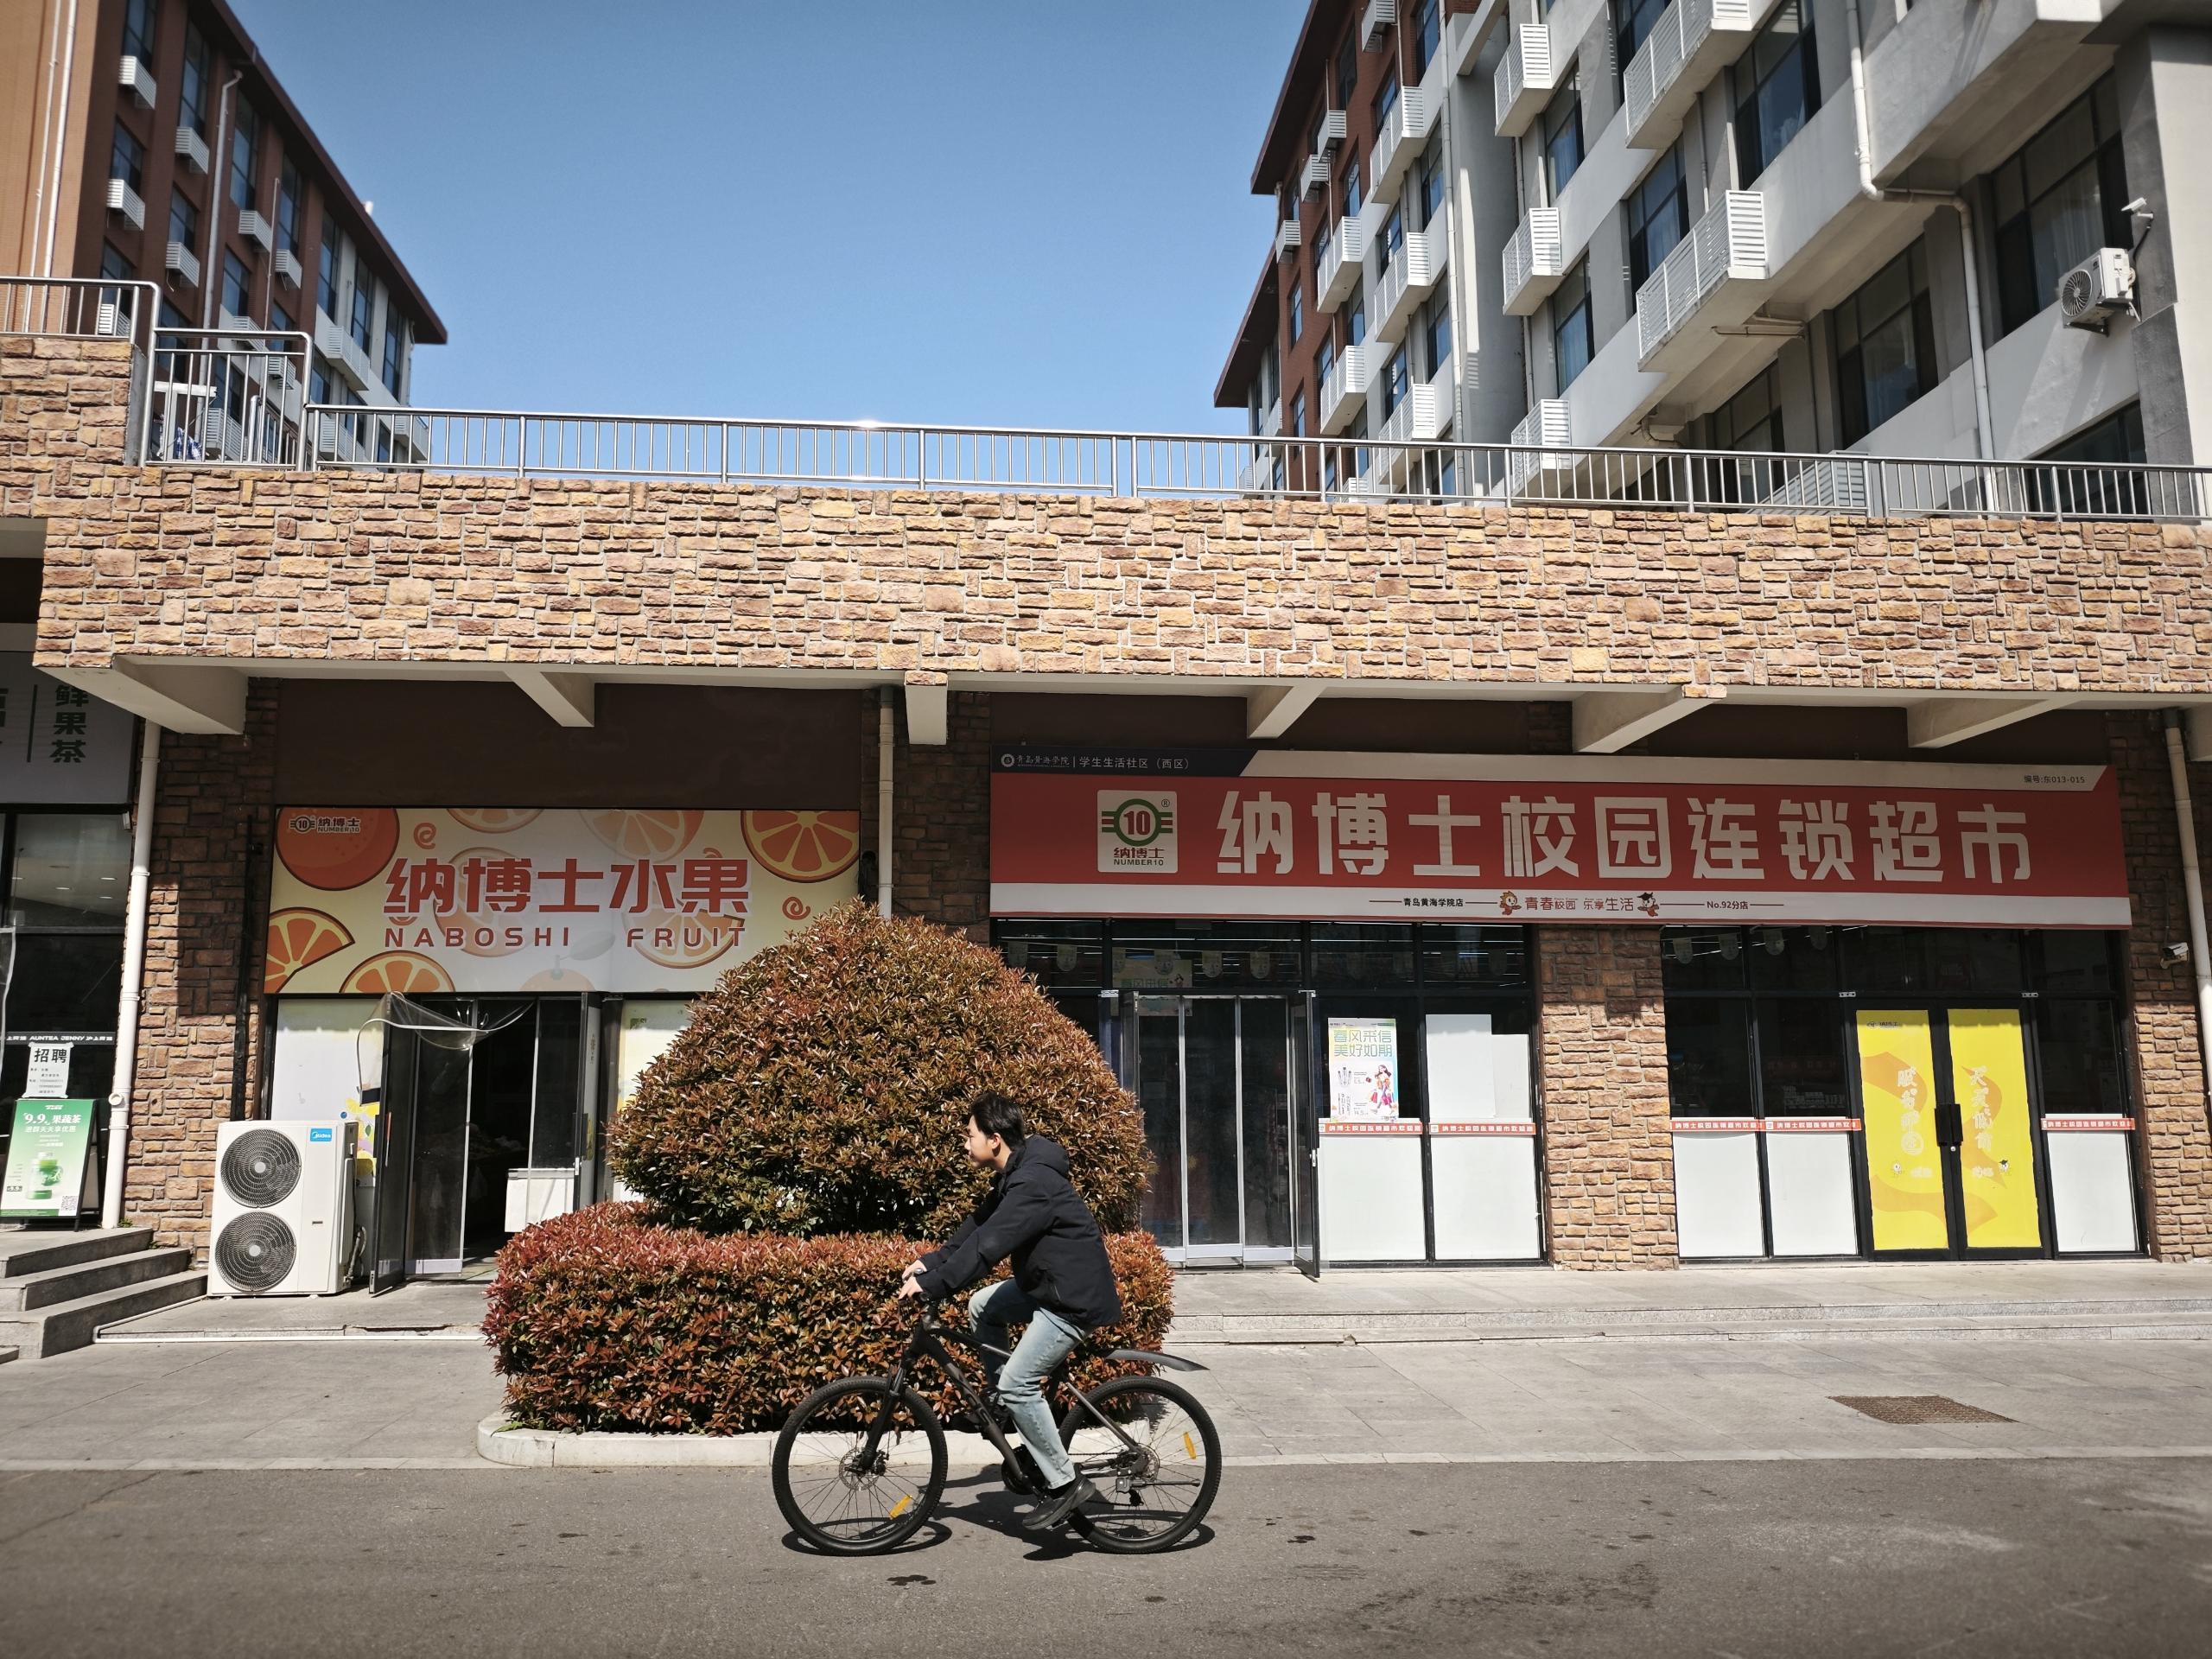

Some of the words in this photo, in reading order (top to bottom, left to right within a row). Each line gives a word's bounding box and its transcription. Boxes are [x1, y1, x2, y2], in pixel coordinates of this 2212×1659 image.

[49, 686, 89, 763] 鲜果茶
[318, 817, 360, 827] 纳博士
[1123, 810, 1150, 835] 10
[1217, 790, 2031, 884] 纳博士校园连锁超市
[1114, 847, 1165, 859] 纳博士
[383, 858, 749, 914] 纳博士水果
[1402, 897, 1464, 907] 青岛黄海学院店
[1524, 896, 1576, 911] 青春校园
[1707, 901, 1749, 910] No.92分店
[385, 927, 570, 948] NABOSHI
[627, 927, 747, 948] FRUIT
[34, 1048, 67, 1064] 招聘
[1333, 1044, 1393, 1058] 美好如期
